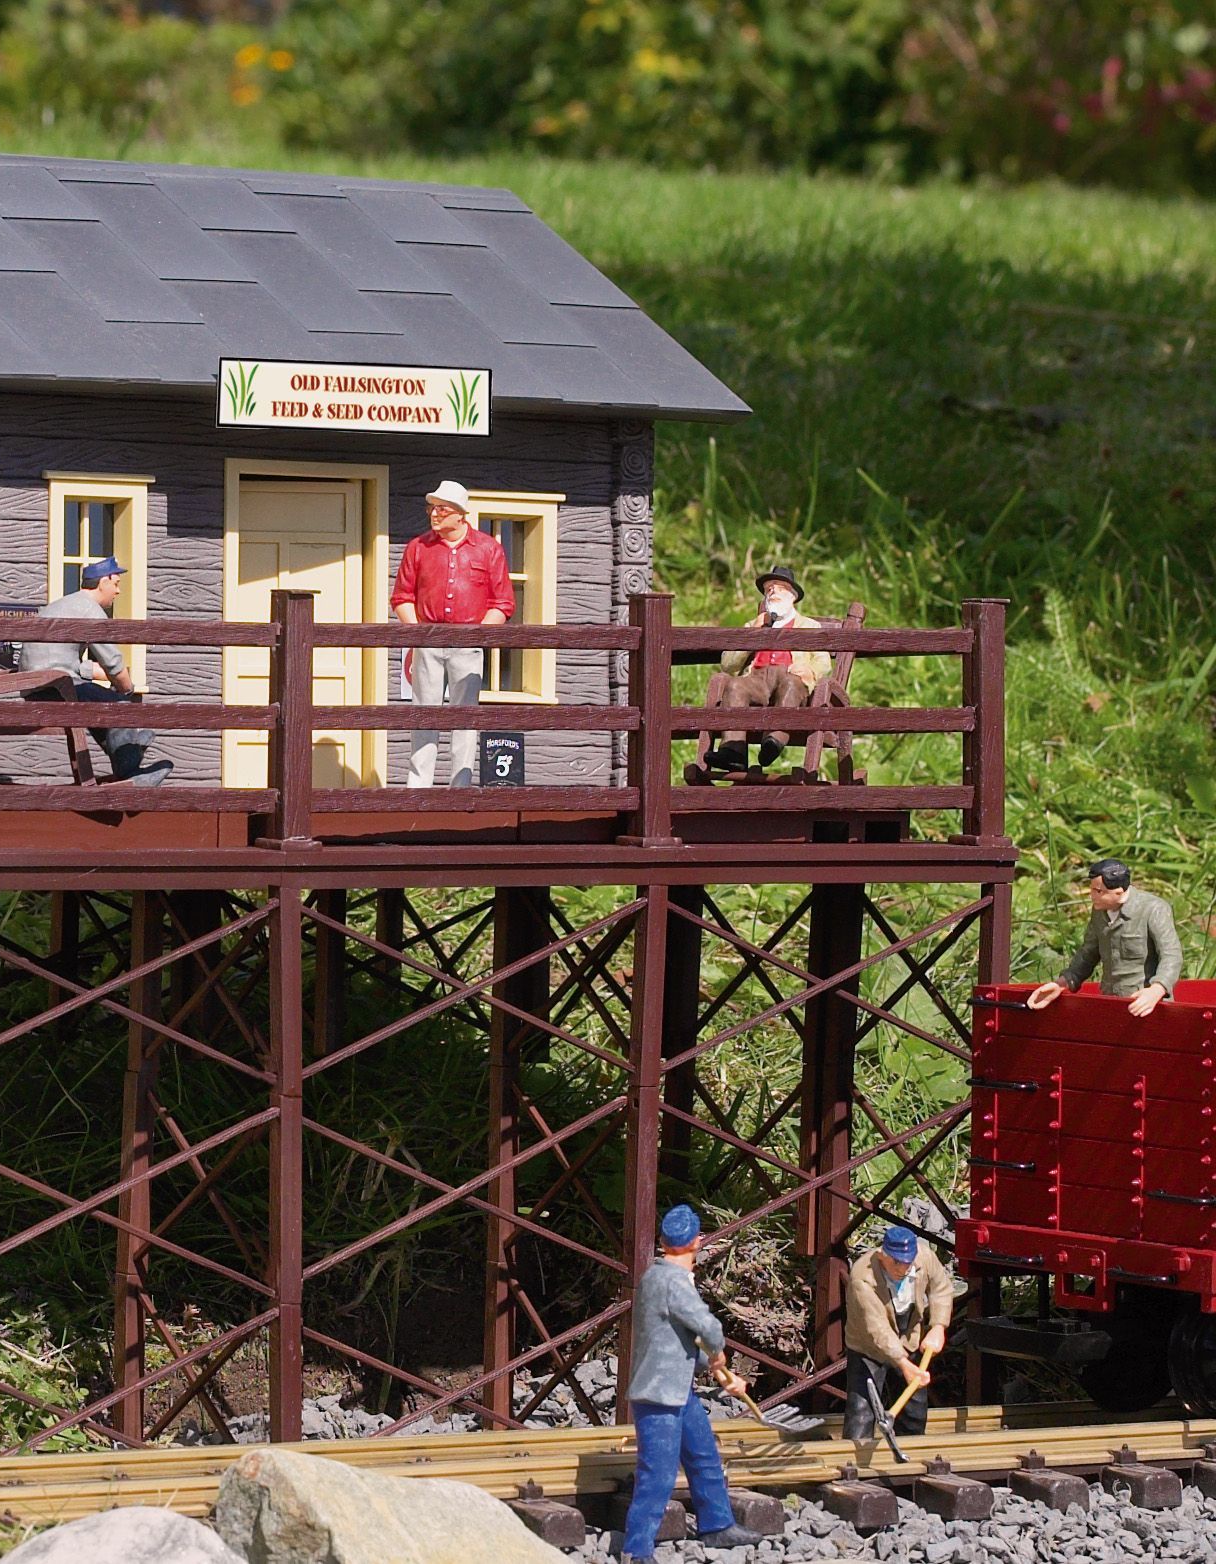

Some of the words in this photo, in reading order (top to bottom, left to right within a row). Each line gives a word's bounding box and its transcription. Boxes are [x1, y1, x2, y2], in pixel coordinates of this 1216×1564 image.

[290, 374, 321, 391] OLD
[323, 375, 426, 396] FALLSINGTON
[271, 400, 309, 418] FEED
[312, 402, 324, 418] &
[327, 403, 363, 420] SEED
[367, 404, 443, 423] COMPANY
